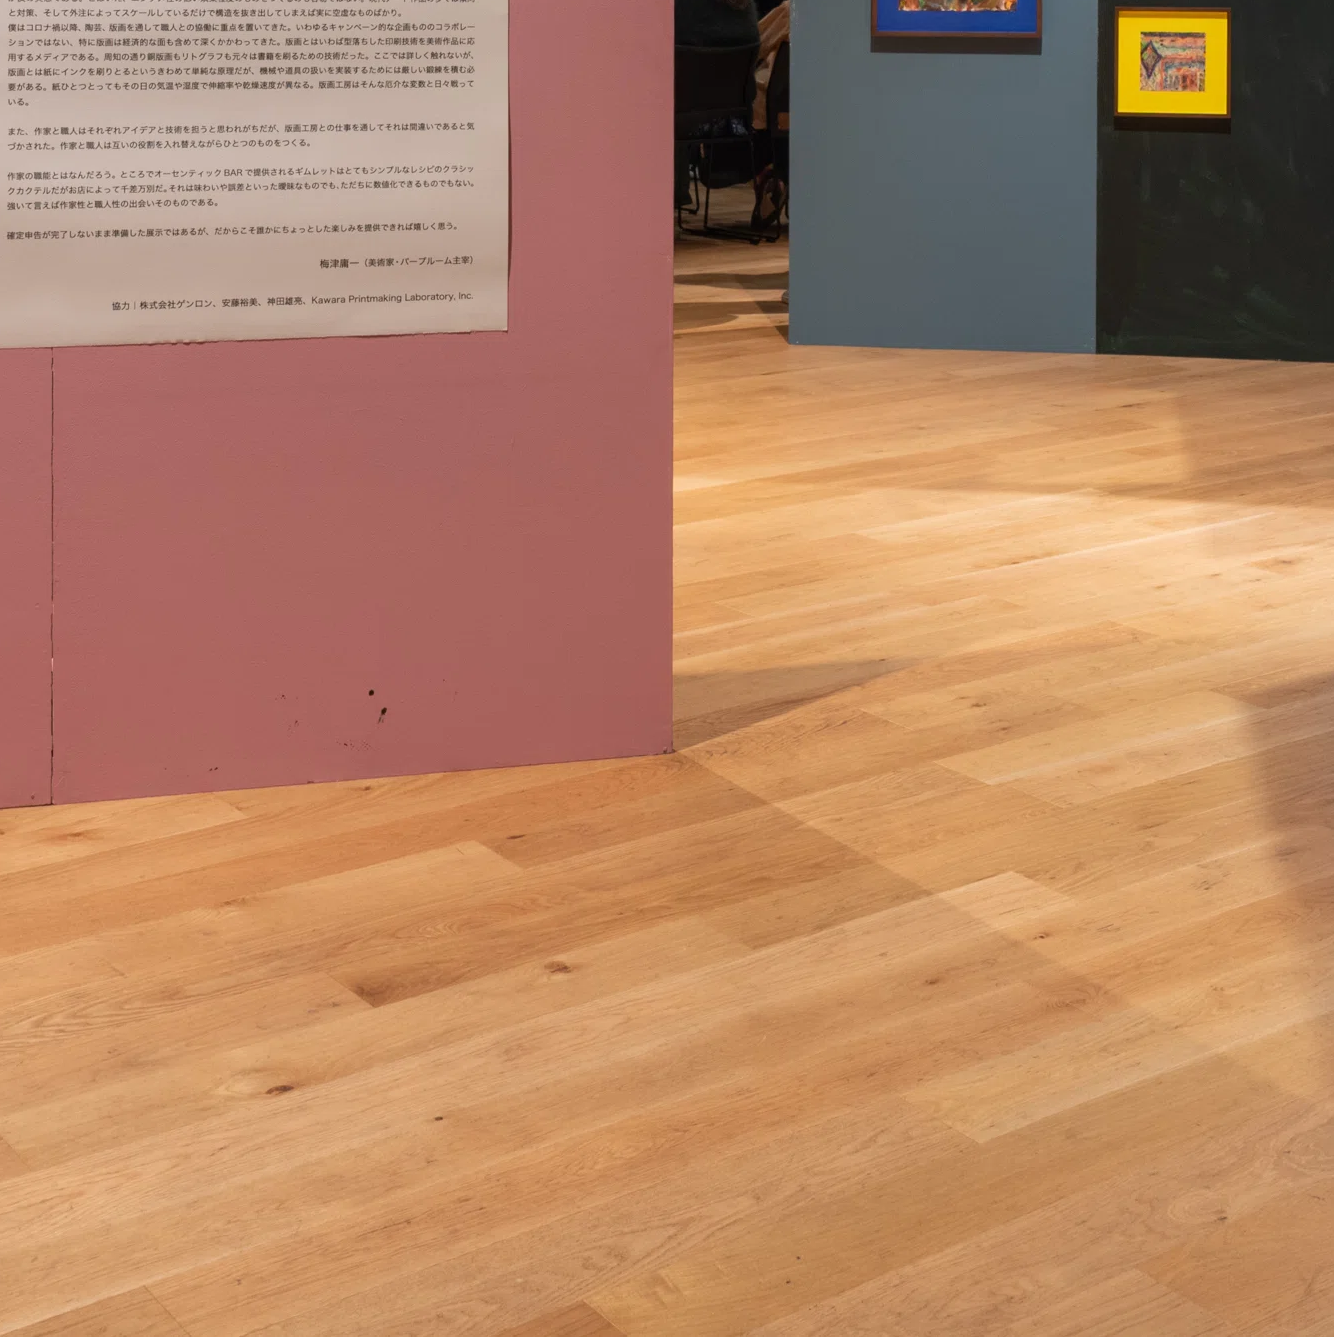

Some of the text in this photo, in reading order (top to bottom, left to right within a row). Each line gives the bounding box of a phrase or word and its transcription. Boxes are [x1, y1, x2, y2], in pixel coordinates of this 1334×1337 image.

[8, 97, 30, 107] いる。
[311, 295, 346, 305] Kawara
[348, 294, 402, 305] Printmaking
[404, 292, 457, 303] Laboratory,
[458, 291, 474, 301] Inc.
